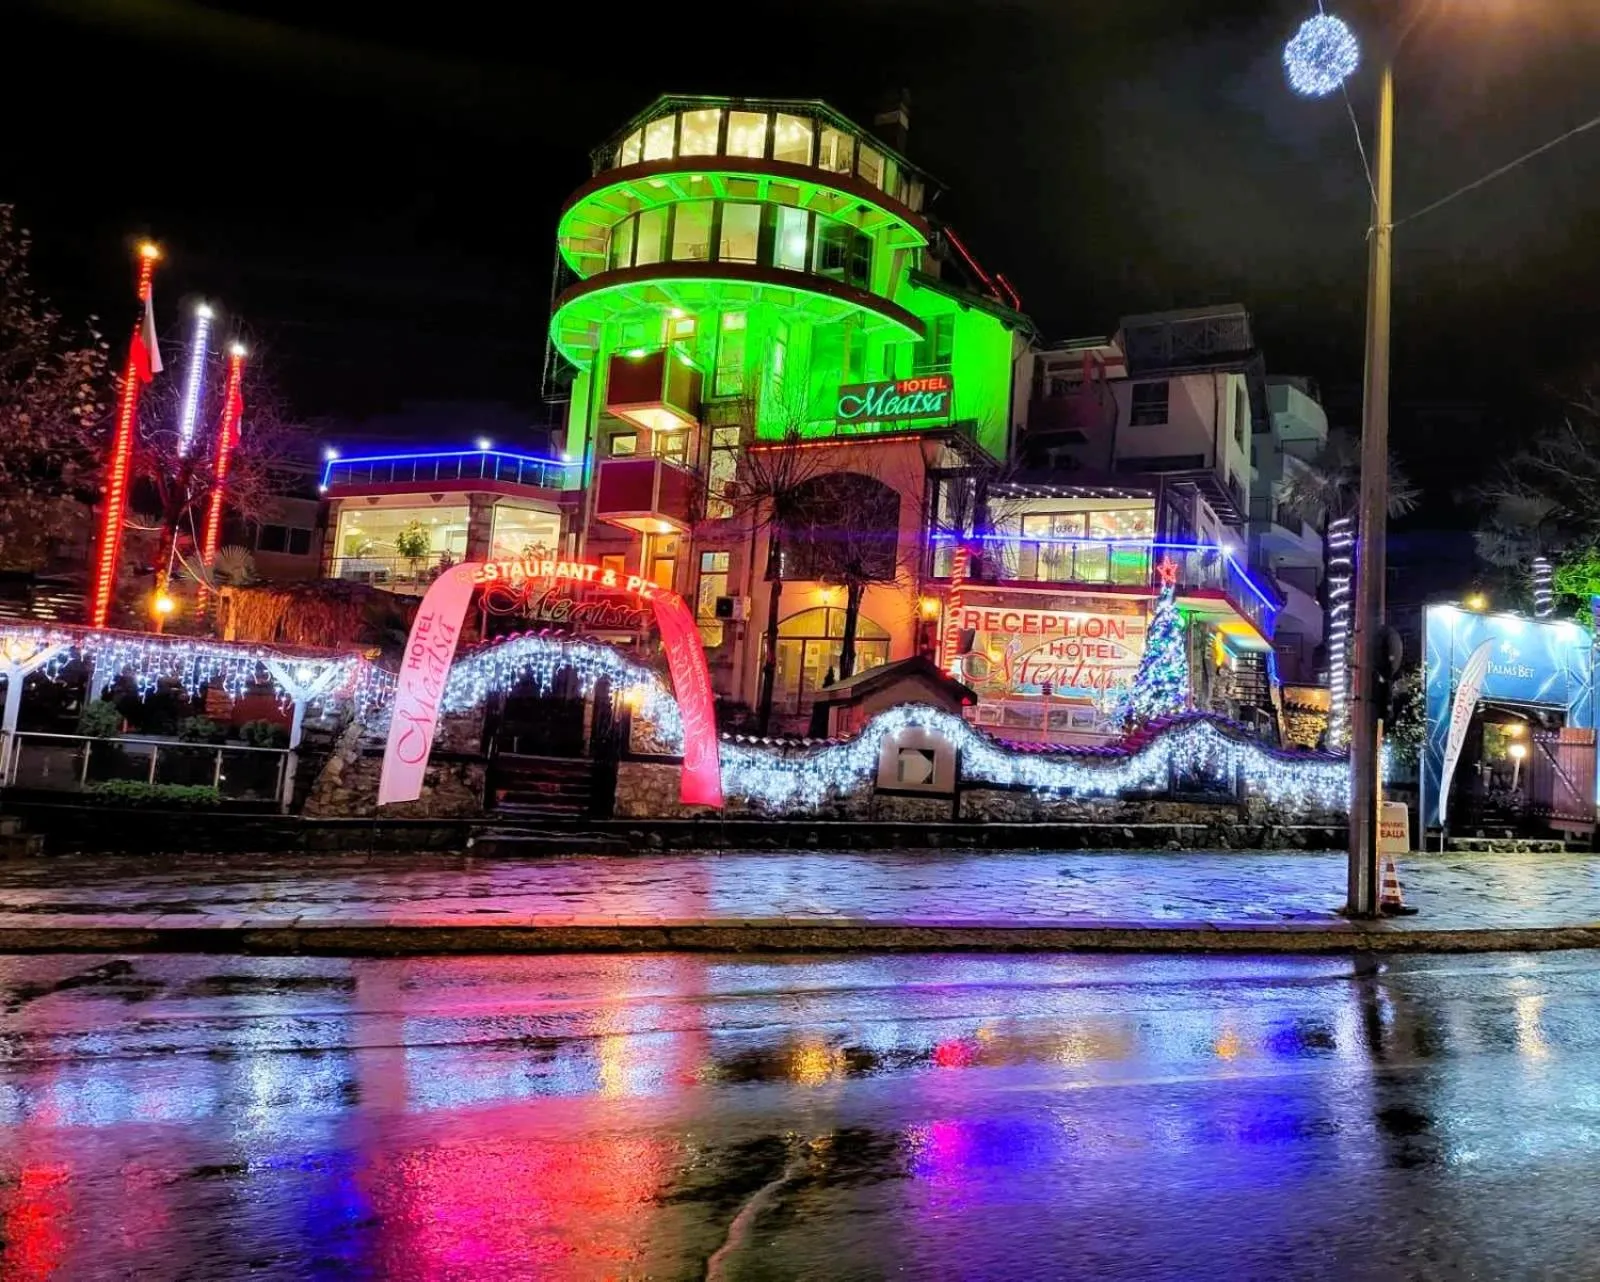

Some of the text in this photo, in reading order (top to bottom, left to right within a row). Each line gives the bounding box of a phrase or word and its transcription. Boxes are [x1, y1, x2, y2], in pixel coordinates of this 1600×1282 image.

[896, 377, 947, 393] HOTEL
[838, 384, 948, 418] Meatsa
[602, 568, 618, 588] &
[963, 610, 1126, 640] RECEPTION
[408, 611, 435, 670] HOTEL
[1049, 642, 1123, 660] HOTEL
